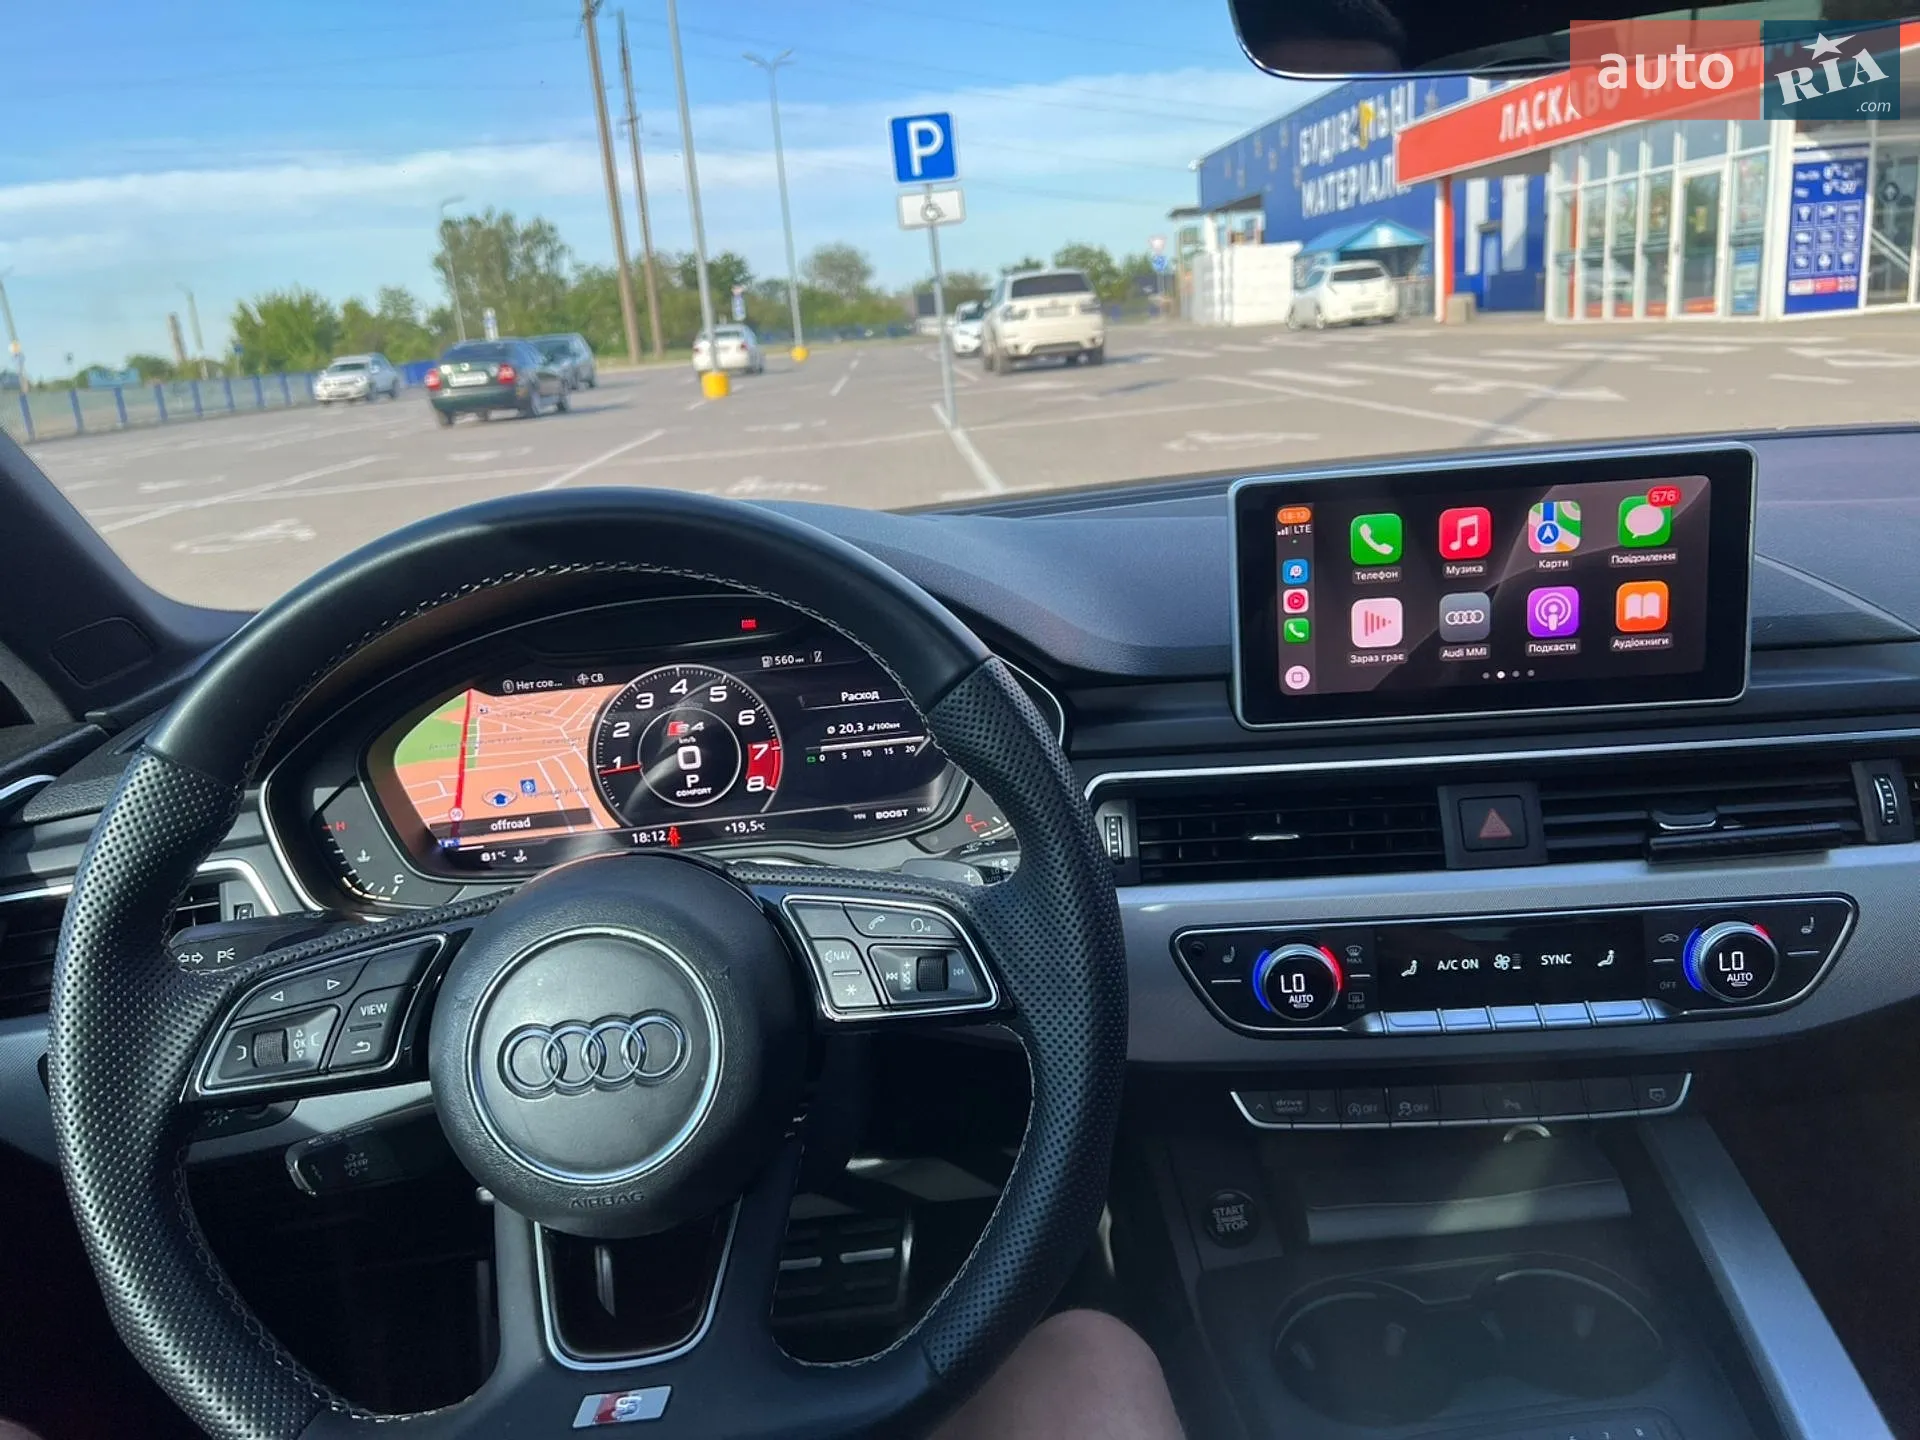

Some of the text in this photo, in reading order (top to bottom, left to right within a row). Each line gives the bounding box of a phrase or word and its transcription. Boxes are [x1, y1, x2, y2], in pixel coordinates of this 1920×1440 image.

[907, 120, 944, 176] P
[1302, 153, 1412, 219] МАТЕРІАЛ
[1651, 490, 1676, 502] 576
[1293, 524, 1312, 534] LTE
[1539, 558, 1569, 570] Карти
[1611, 551, 1677, 565] Повідомлення
[1355, 570, 1398, 582] Телефон
[1446, 564, 1484, 576] Музика
[1529, 642, 1577, 655] Подкасти
[1613, 636, 1669, 650] Аудіокниги
[1350, 652, 1405, 665] Зараз грає
[1442, 647, 1487, 658] Audi MMI
[774, 655, 794, 665] 560
[516, 681, 534, 691] Нет
[669, 679, 688, 695] 4
[709, 685, 728, 702] 5
[841, 691, 880, 702] Расход
[635, 692, 654, 710] 3
[738, 710, 756, 726] 6
[612, 721, 631, 738] 2
[838, 722, 864, 735] 20,3
[677, 745, 702, 771] 0
[752, 744, 769, 761] 7
[819, 745, 916, 762] 0 5 10 15 20
[612, 756, 622, 769] 1
[686, 774, 700, 788] P
[747, 776, 766, 792] 8
[675, 787, 712, 798] COMFORT
[875, 809, 909, 820] BOOST
[490, 817, 531, 832] offroad
[631, 830, 667, 845] 18:12
[394, 874, 405, 884] C
[833, 951, 851, 961] NAV
[1541, 953, 1573, 966] SYNC
[1437, 959, 1479, 971] A/C ON
[1726, 972, 1754, 983] AUTO
[1288, 994, 1314, 1004] AUTO
[360, 1003, 388, 1017] VIEW
[293, 1038, 307, 1049] OK
[569, 1190, 645, 1209] AIRBAG
[1211, 1204, 1245, 1218] START
[1216, 1219, 1249, 1233] STOP
